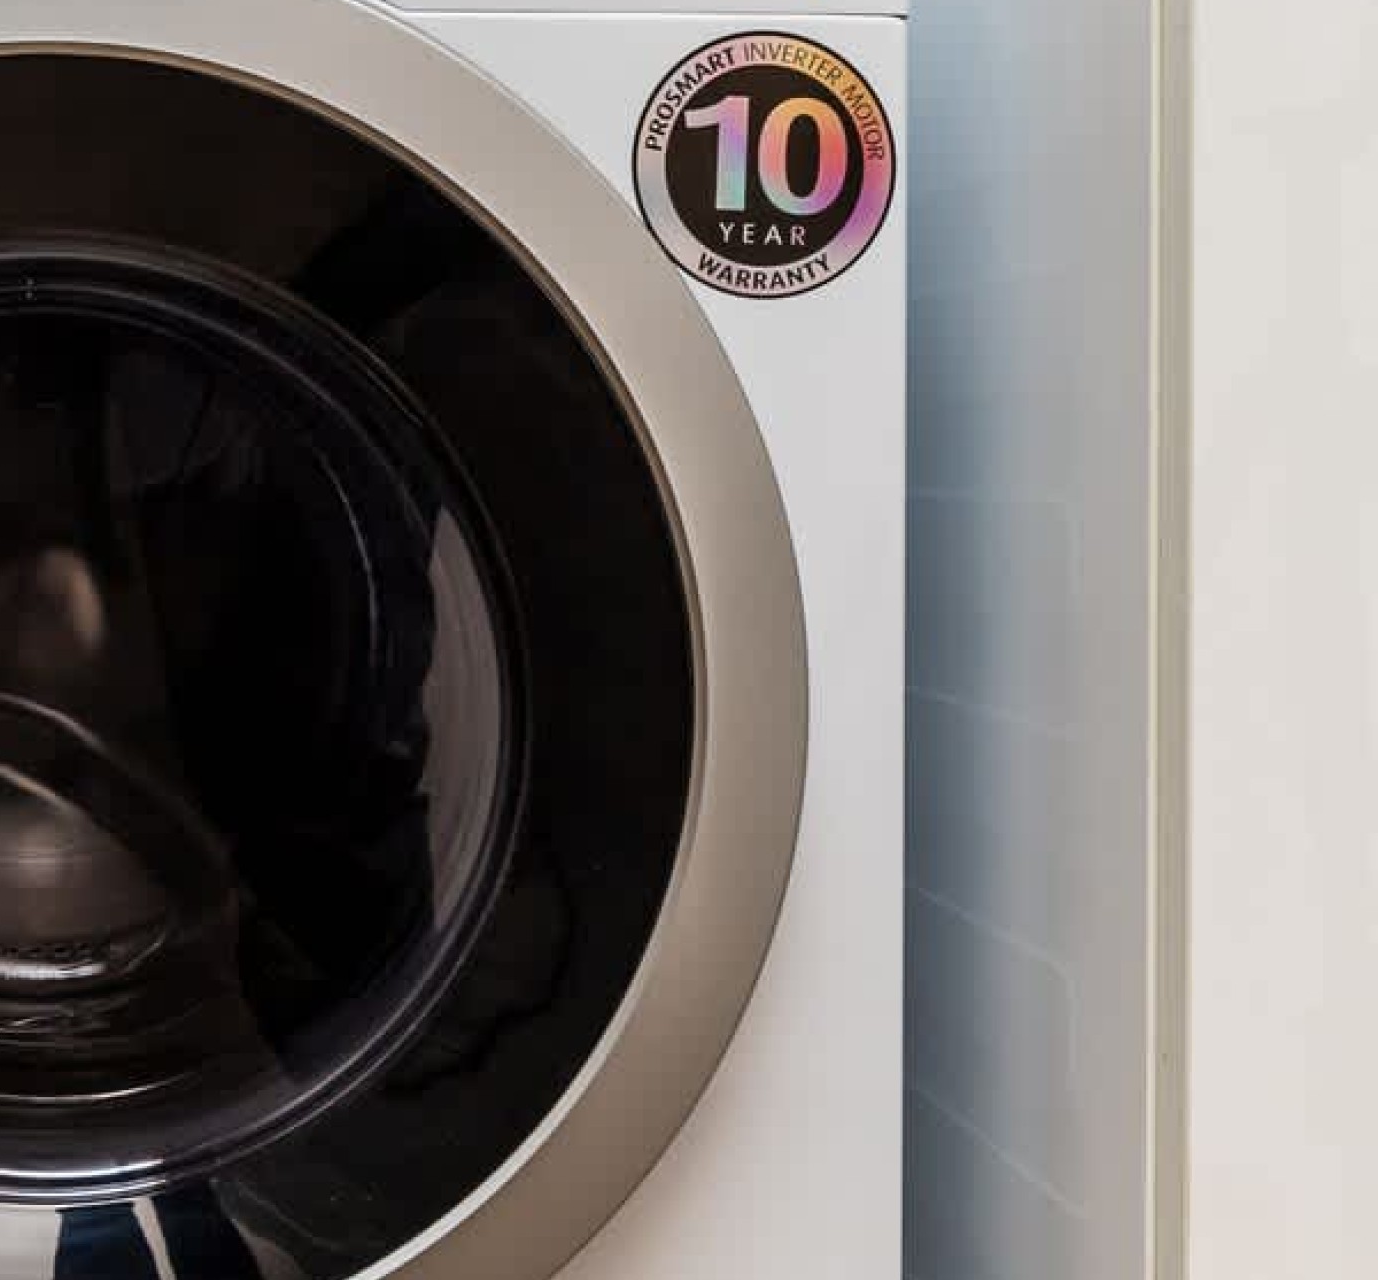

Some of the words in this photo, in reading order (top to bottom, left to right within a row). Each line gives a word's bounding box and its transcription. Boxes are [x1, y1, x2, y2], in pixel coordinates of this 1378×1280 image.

[644, 46, 737, 152] PROSMART
[743, 41, 846, 84] INVERTER
[842, 83, 885, 162] MOTOR
[684, 94, 849, 217] 10
[696, 252, 831, 291] WARRANTY
[718, 222, 807, 246] YEAR
